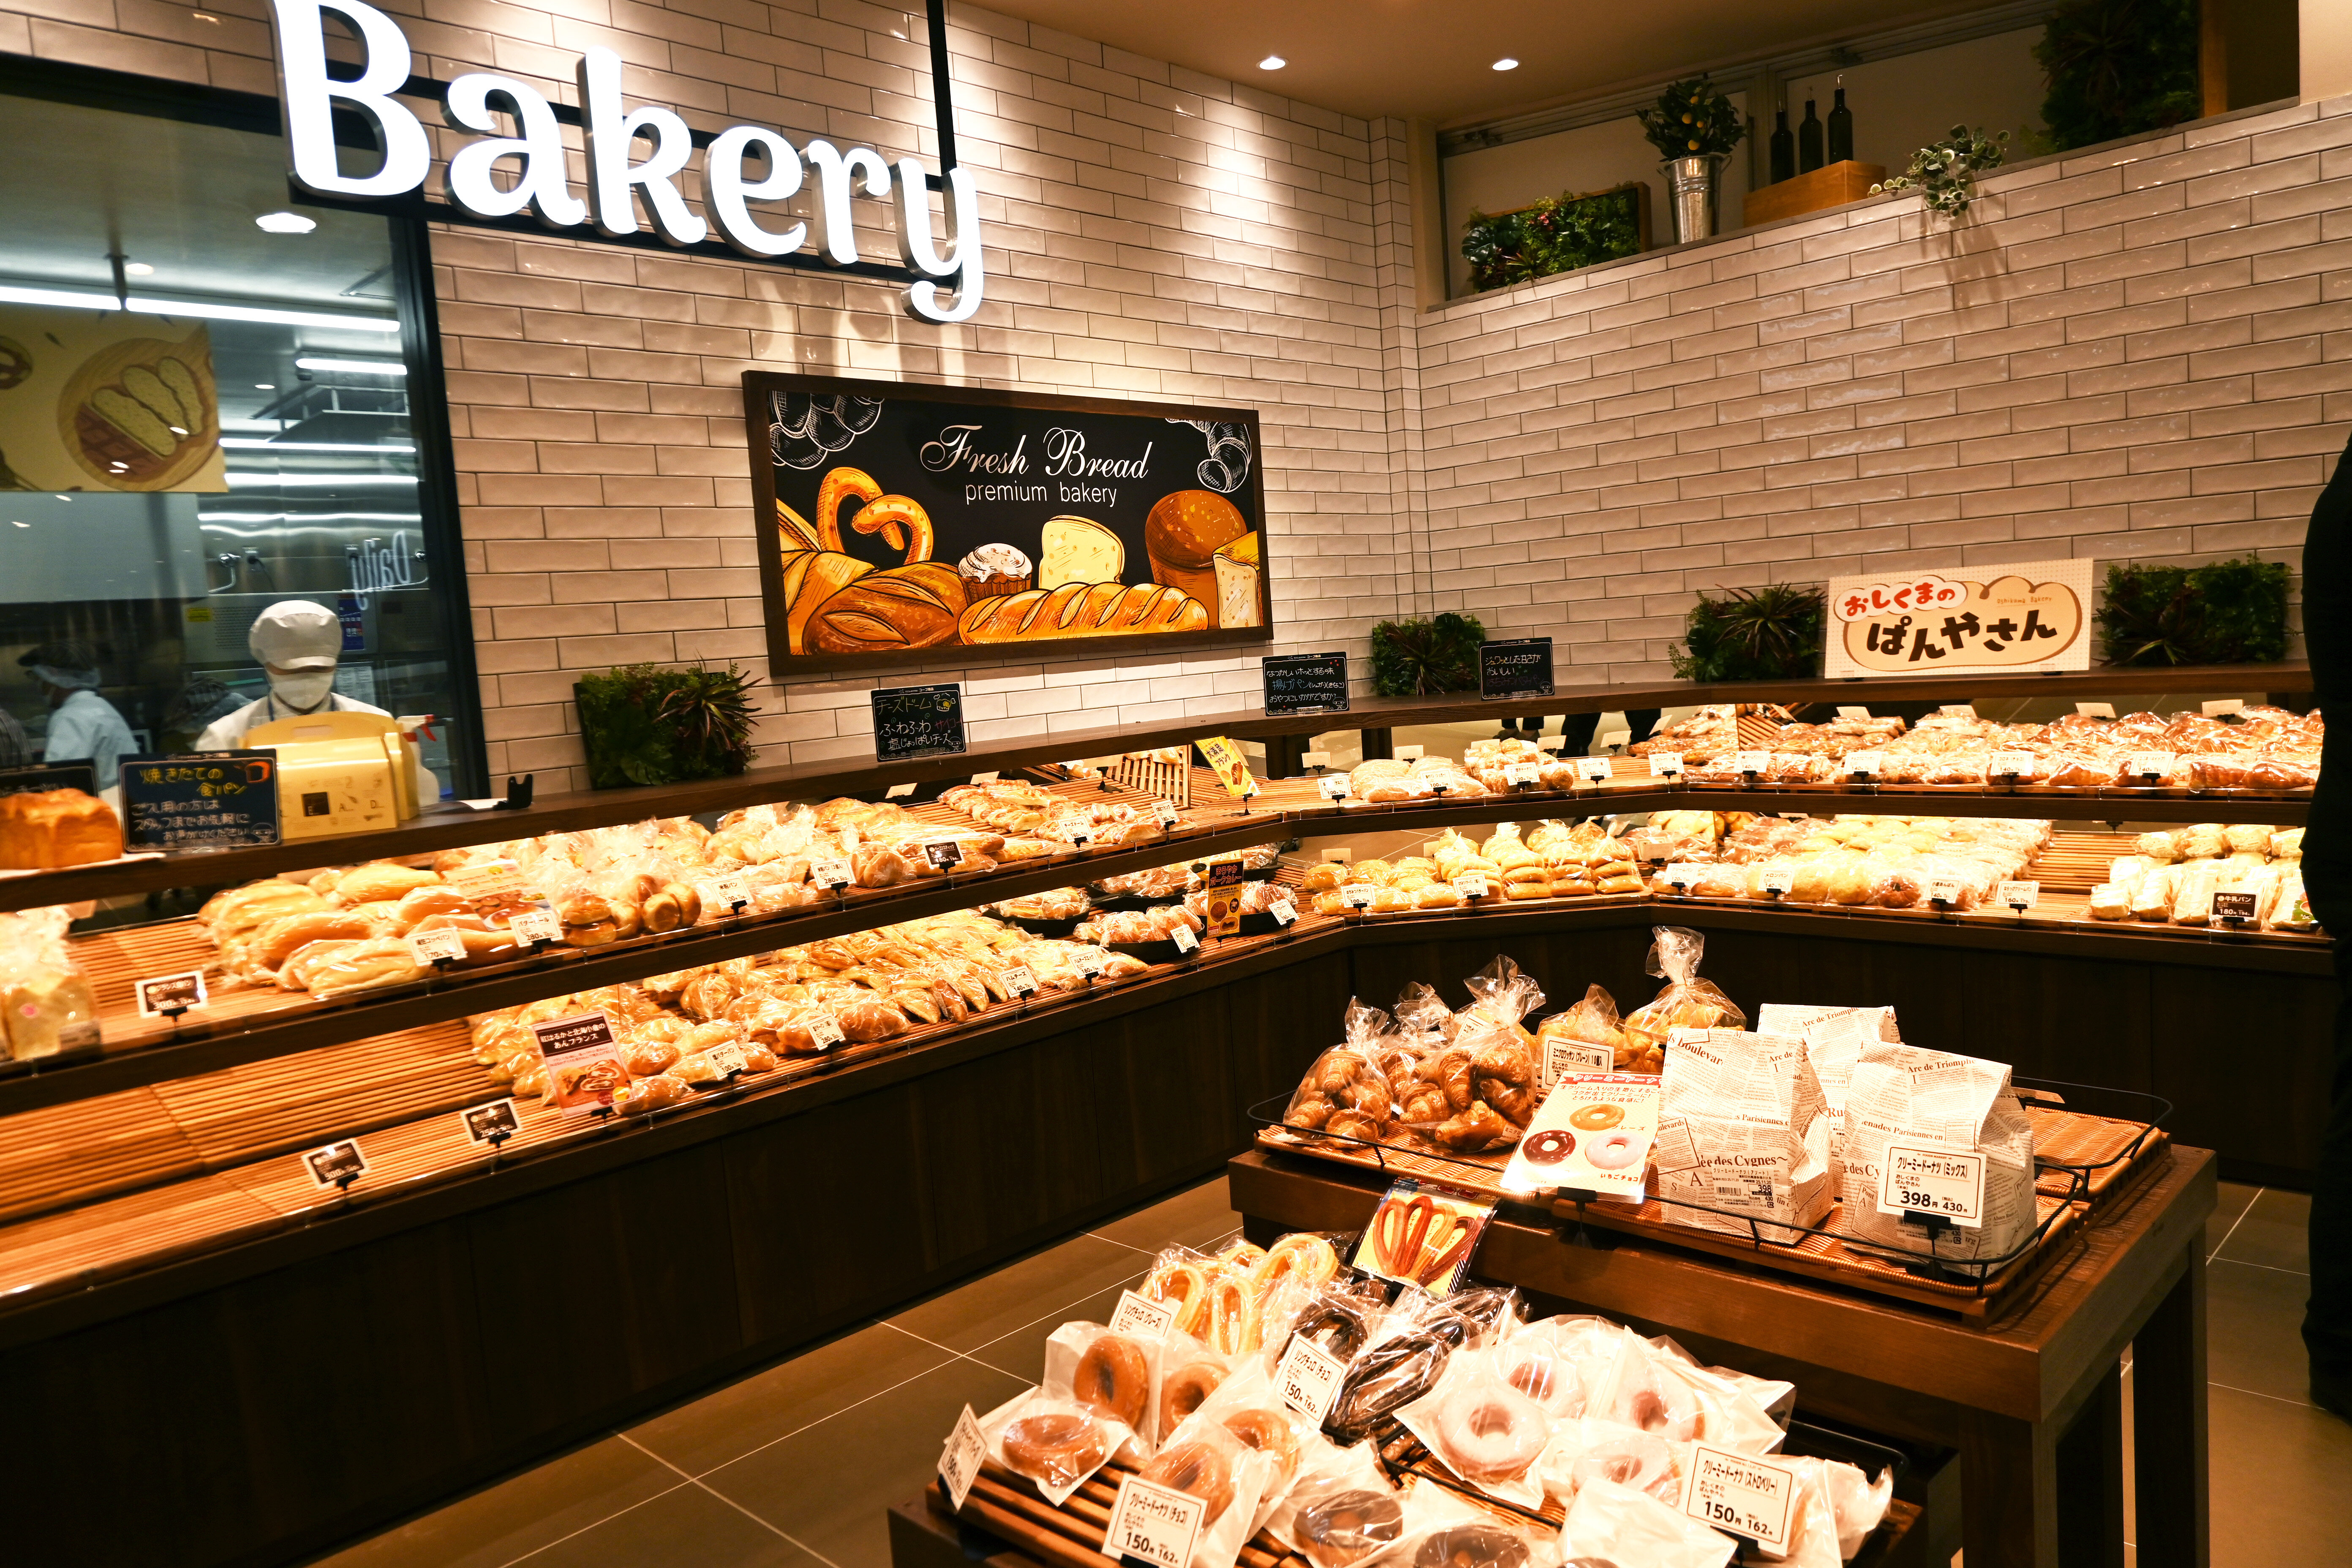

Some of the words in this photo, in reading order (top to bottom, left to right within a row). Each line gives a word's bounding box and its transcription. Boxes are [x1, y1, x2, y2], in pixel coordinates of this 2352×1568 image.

[269, 0, 983, 324] Bakery
[920, 424, 1029, 474] Fresh
[1043, 427, 1152, 479] Bread
[965, 481, 1047, 504] premium
[1060, 485, 1117, 507] bakery
[1844, 582, 1955, 617] おしくまの
[1866, 609, 2058, 662] ぱんやさん
[1266, 667, 1335, 677] なつかしいホッとする味
[1486, 667, 1515, 676] おいしい
[876, 696, 931, 715] チーズドーム
[879, 720, 931, 736] ふわふわ
[1205, 743, 1225, 760] 大満足
[1215, 753, 1231, 767] フランク
[141, 767, 223, 784] 焼きたての
[197, 782, 247, 797] 食パン
[1216, 865, 1238, 876] まろやか
[1006, 972, 1027, 981] ハムチーズ
[553, 1033, 599, 1049] あんフランス
[1769, 1055, 1783, 1063] Arc
[1907, 1064, 1922, 1073] Arc
[1935, 1059, 1976, 1069] Triomphe
[1742, 1113, 1783, 1125] Parisiennes
[1862, 1120, 1891, 1133] enades
[1893, 1127, 1933, 1139] Parisiennes
[1934, 1132, 1943, 1141] en
[1715, 1156, 1732, 1165] des
[1850, 1163, 1864, 1176] des
[1600, 1173, 1639, 1182] いちごチョコ
[1690, 1172, 1703, 1186] A
[1758, 1184, 1772, 1192] 398
[1862, 1187, 1874, 1200] Pont
[1859, 1197, 1867, 1208] A
[1446, 1236, 1456, 1247] チョコ
